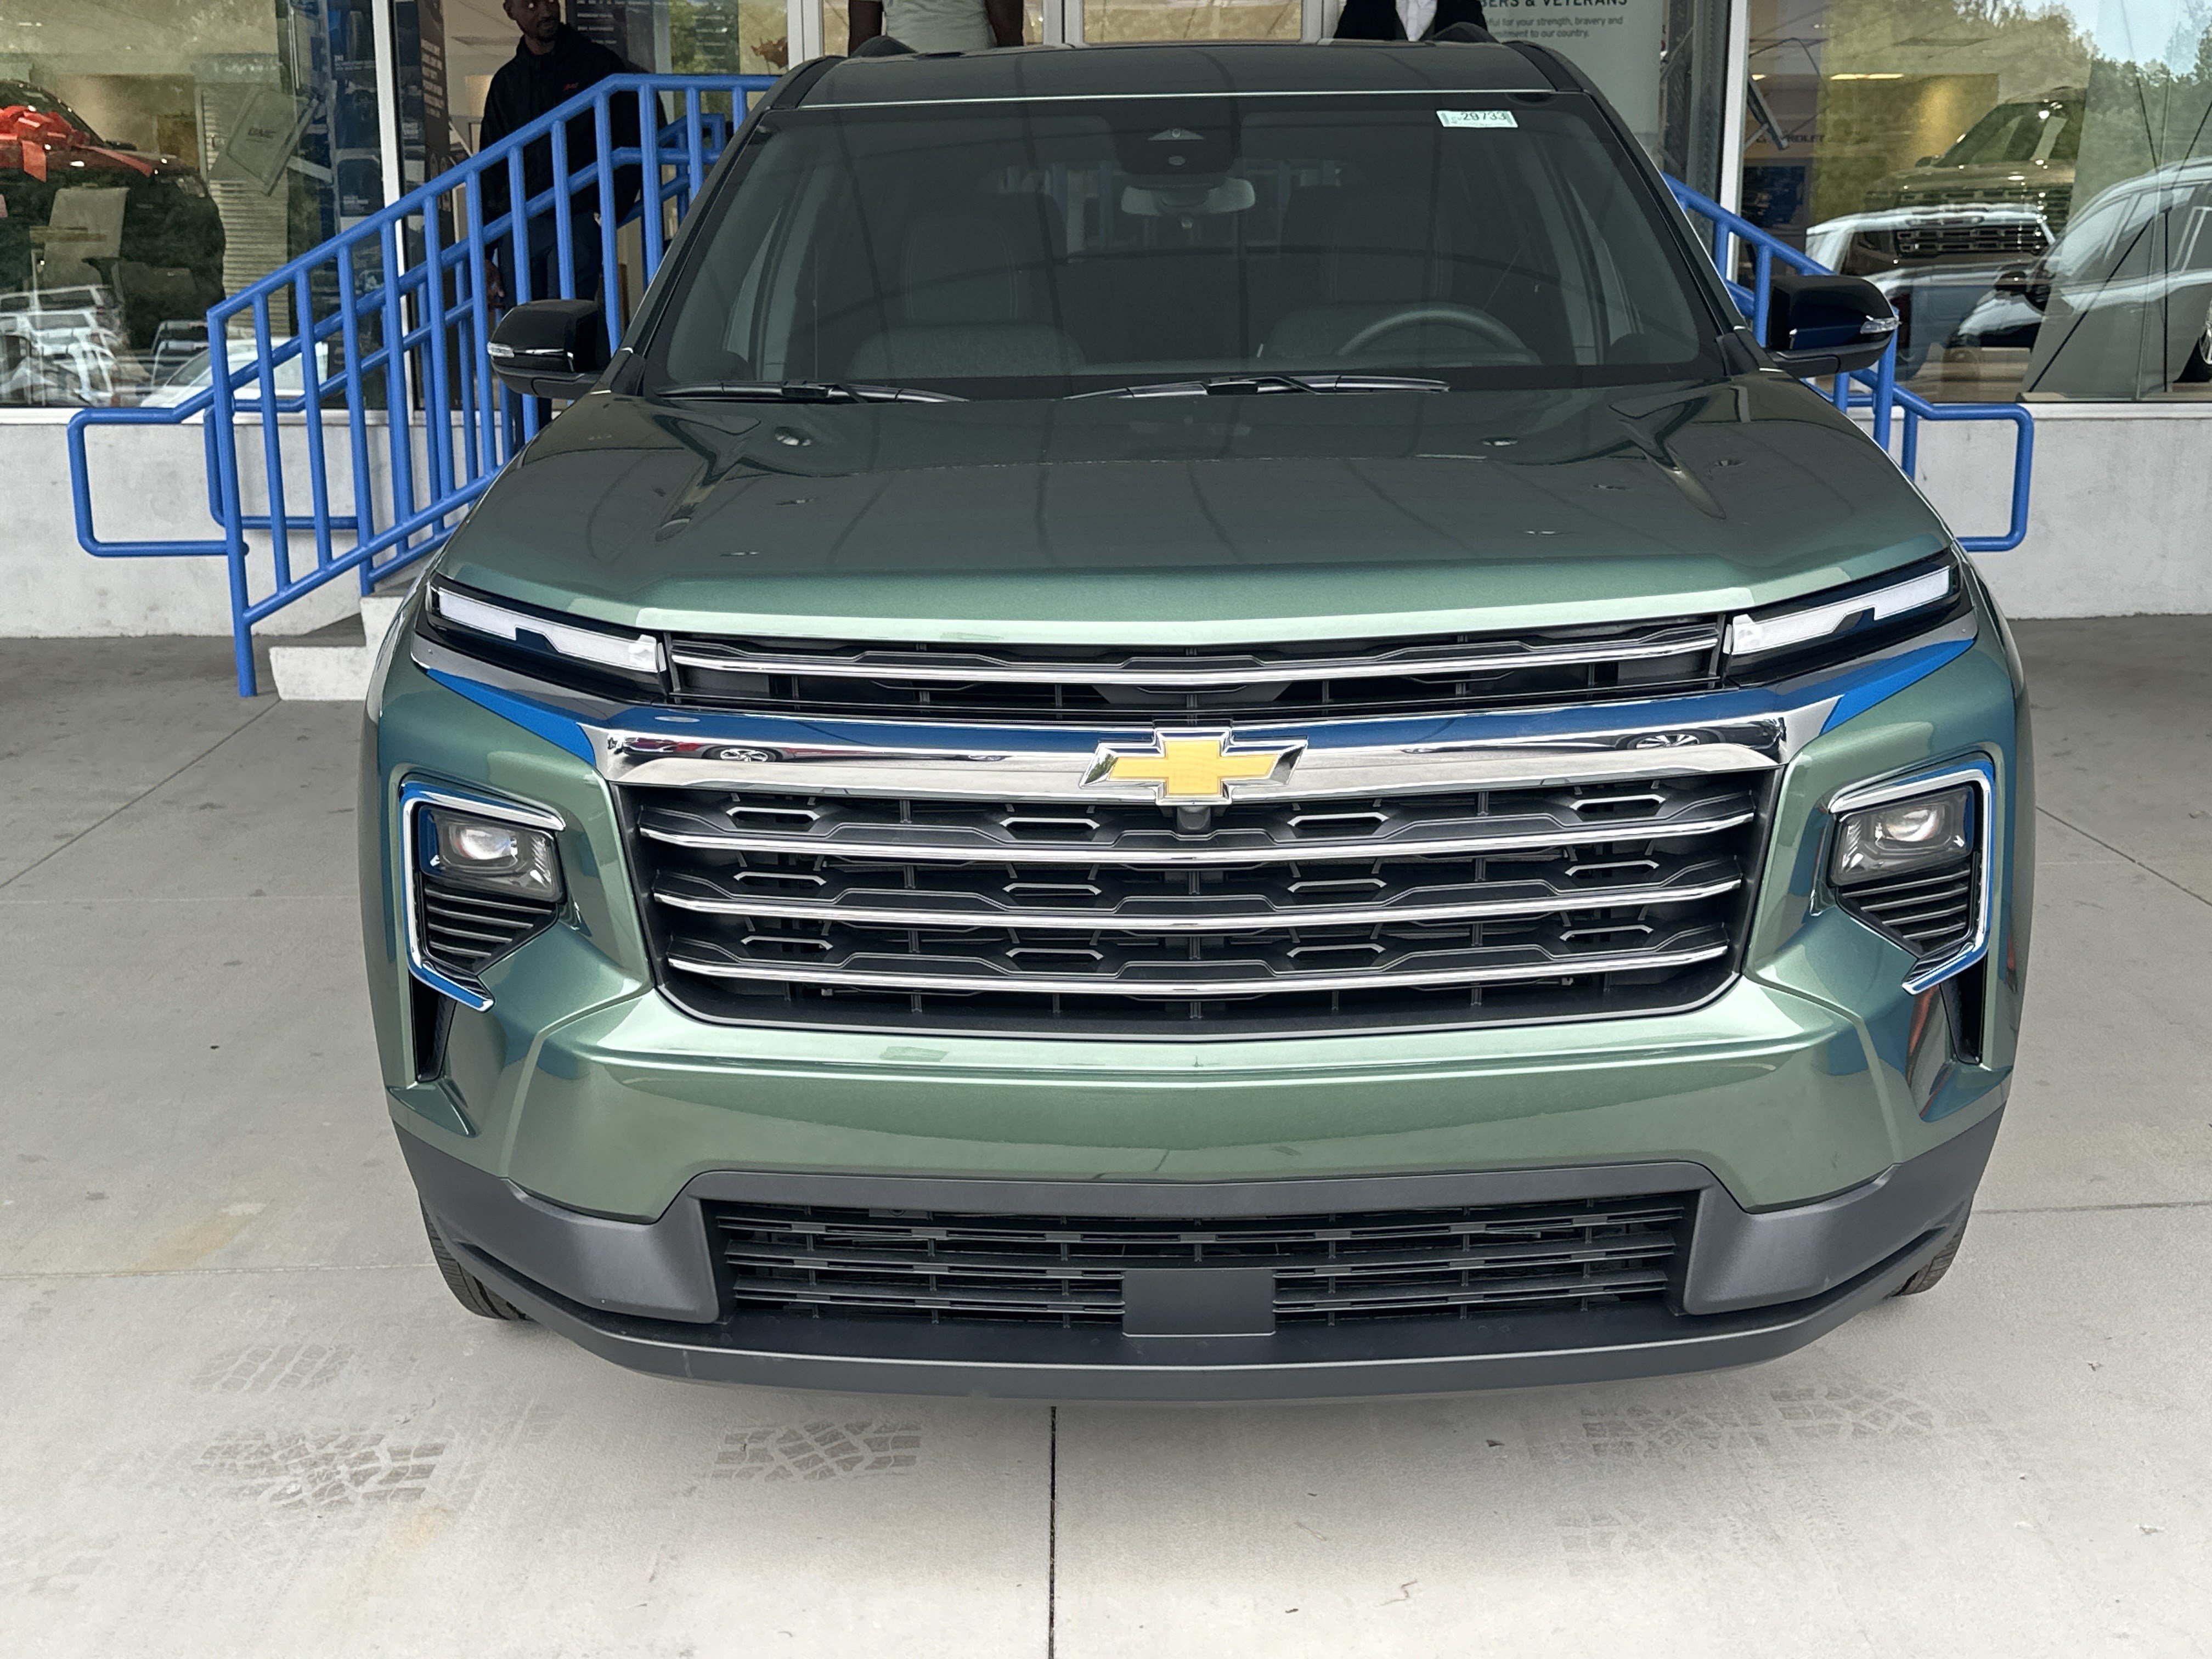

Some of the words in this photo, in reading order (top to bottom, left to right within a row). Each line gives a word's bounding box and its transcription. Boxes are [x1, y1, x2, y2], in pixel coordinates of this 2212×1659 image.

[1502, 18, 1514, 26] for
[1516, 19, 1534, 27] your
[1536, 17, 1573, 27] strength,
[1575, 16, 1606, 26] bravery
[1607, 16, 1623, 25] and
[1530, 29, 1539, 38] to
